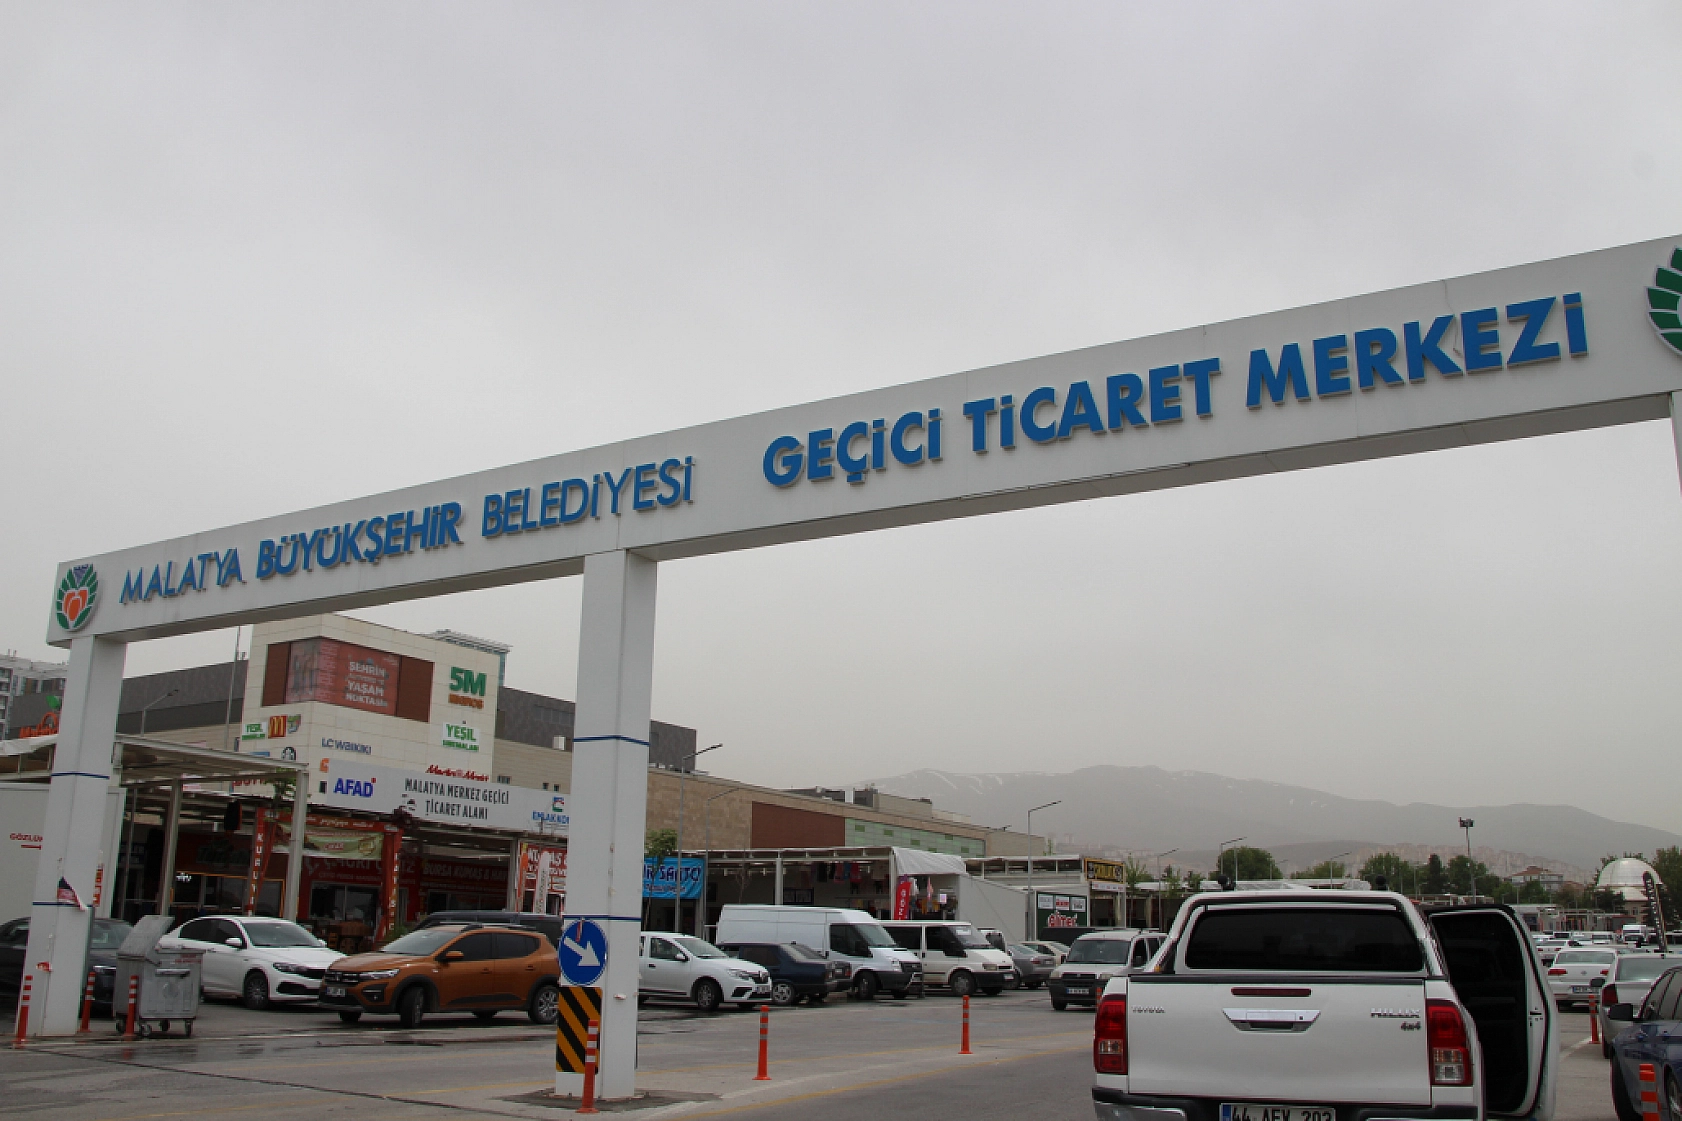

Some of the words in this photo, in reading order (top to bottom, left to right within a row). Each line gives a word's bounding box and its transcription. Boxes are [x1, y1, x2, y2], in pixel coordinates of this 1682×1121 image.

[119, 547, 243, 604] MALATYA
[256, 501, 462, 579] BÜYÜKŞEHİR
[482, 456, 694, 537] BELEDİYESİ
[763, 408, 940, 484] GEÇİCİ
[963, 358, 1220, 453] TİCARET
[1246, 292, 1589, 409] MERKEZİ
[449, 667, 487, 696] 5M
[446, 723, 476, 742] YEŞİL
[333, 777, 374, 798] AFAD
[404, 777, 445, 797] MALATYA
[447, 784, 480, 801] MERKEZ
[462, 803, 488, 820] ALANI
[1231, 1106, 1251, 1121] 44
